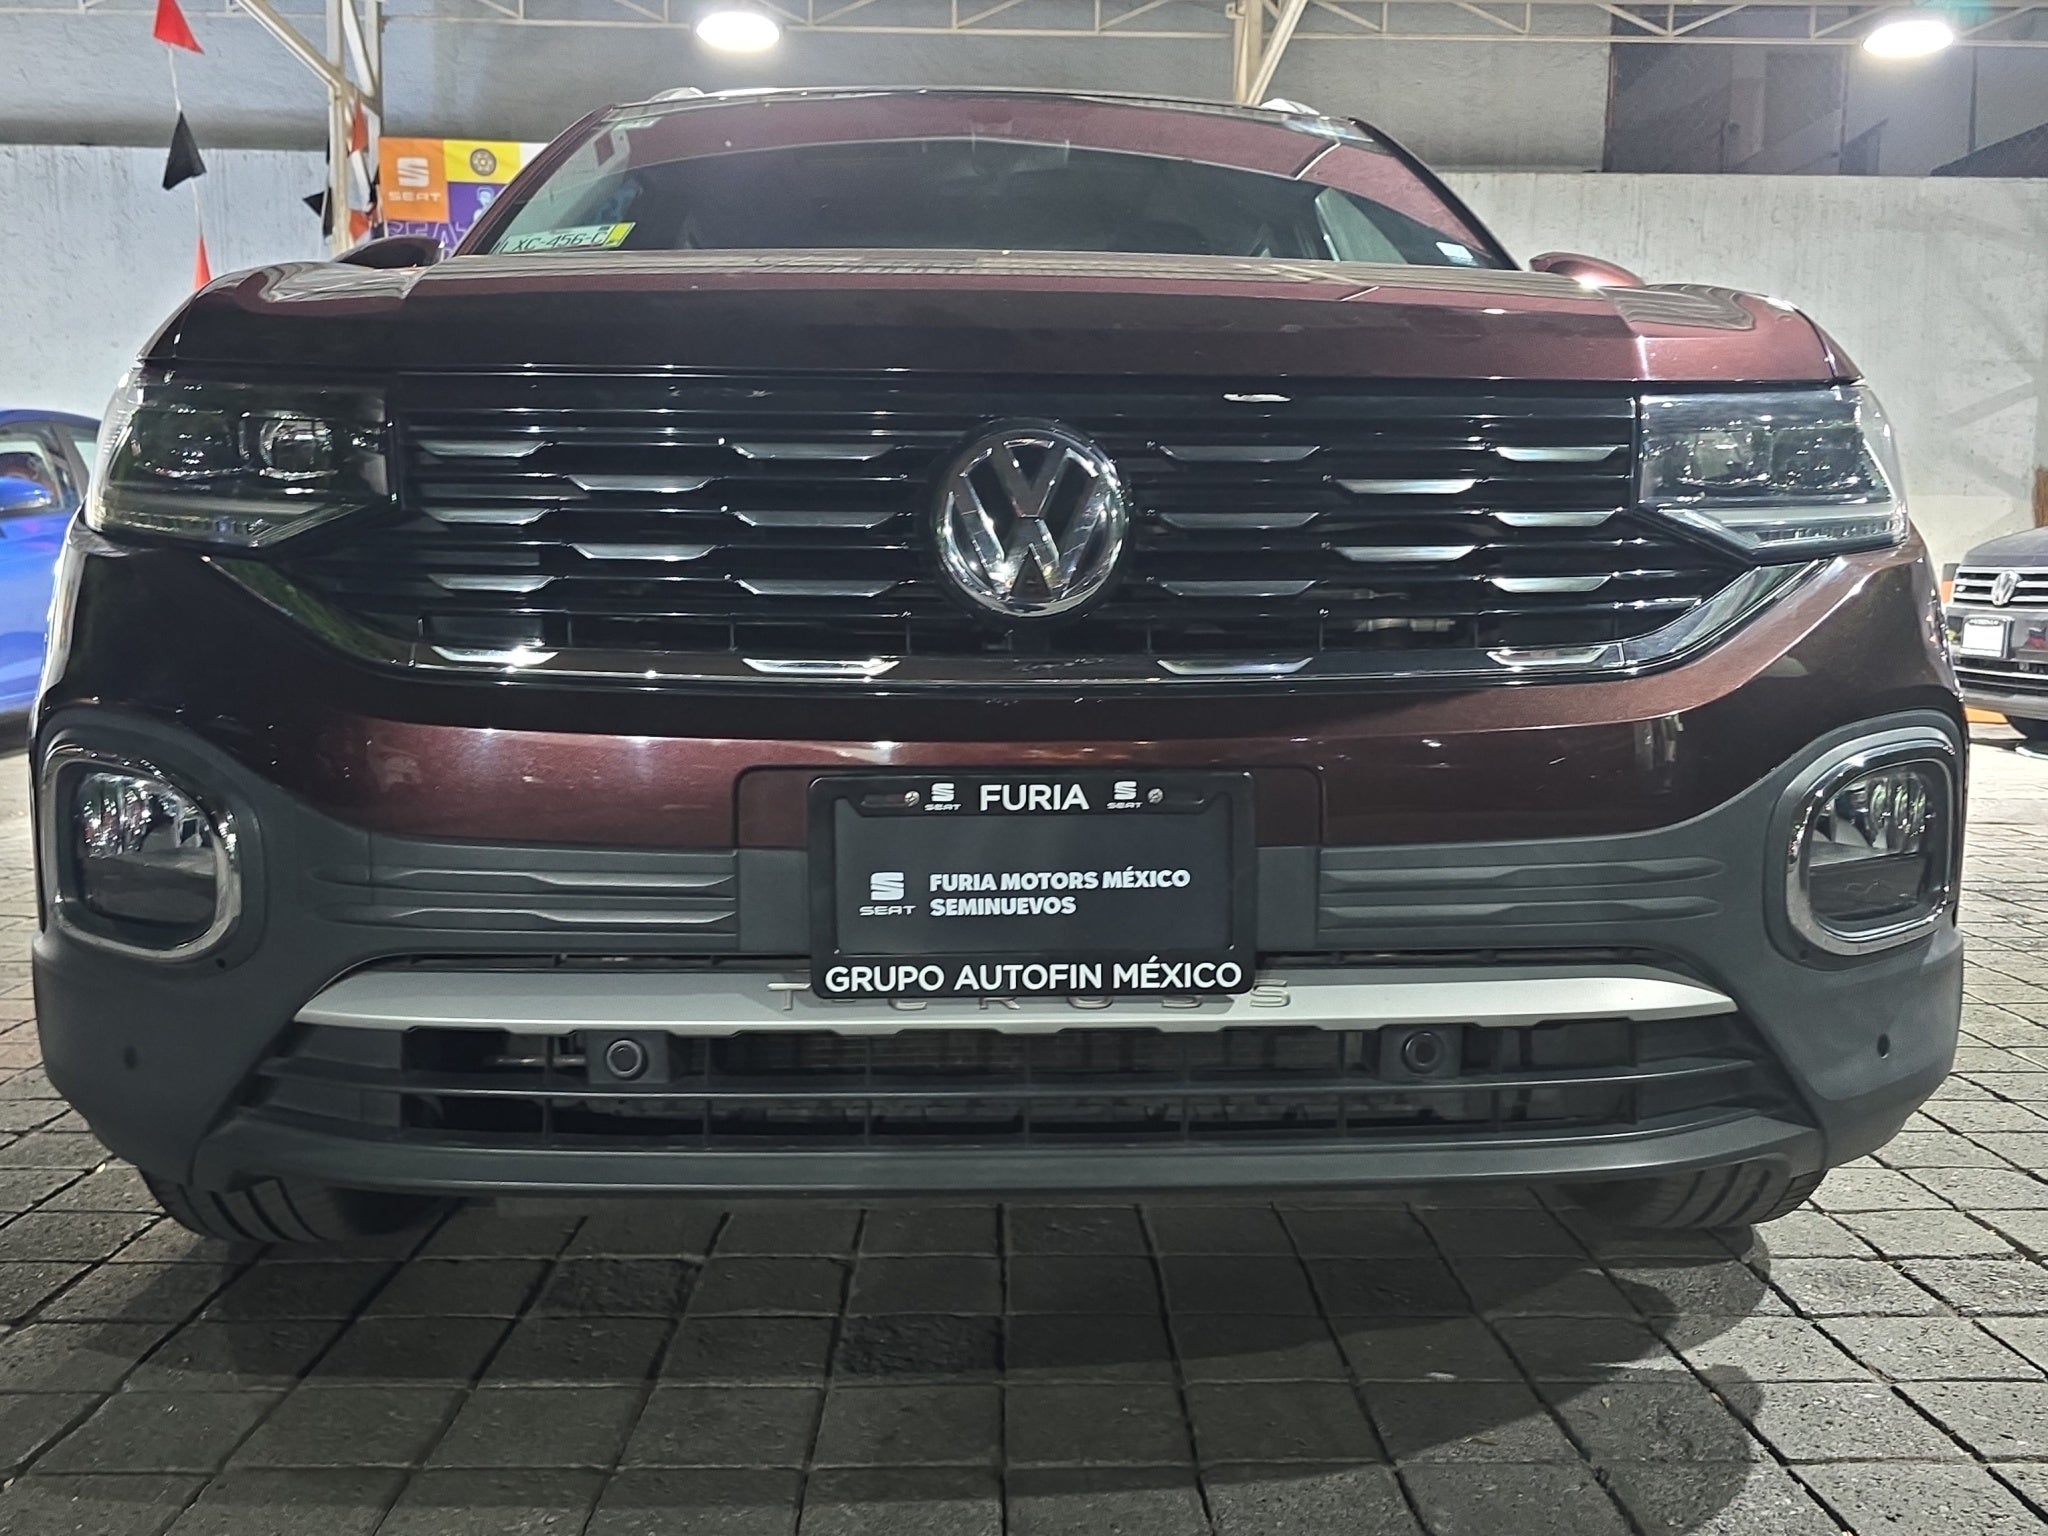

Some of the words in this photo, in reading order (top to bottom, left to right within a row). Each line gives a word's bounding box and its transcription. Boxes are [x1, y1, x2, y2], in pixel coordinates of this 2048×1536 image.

[388, 191, 441, 202] SEAT
[979, 783, 1090, 812] FURIA
[1106, 800, 1144, 810] SEAT
[924, 802, 962, 812] SEAT
[929, 873, 998, 892] FURIA
[1000, 871, 1099, 890] MOTORS
[1101, 865, 1191, 889] MÉXICO
[859, 905, 917, 917] SEAT
[929, 896, 1077, 917] SEMINUEVOS
[824, 964, 945, 993] GRUPO
[954, 962, 1102, 991] AUTOFIN
[1113, 956, 1243, 989] MÉXICO
